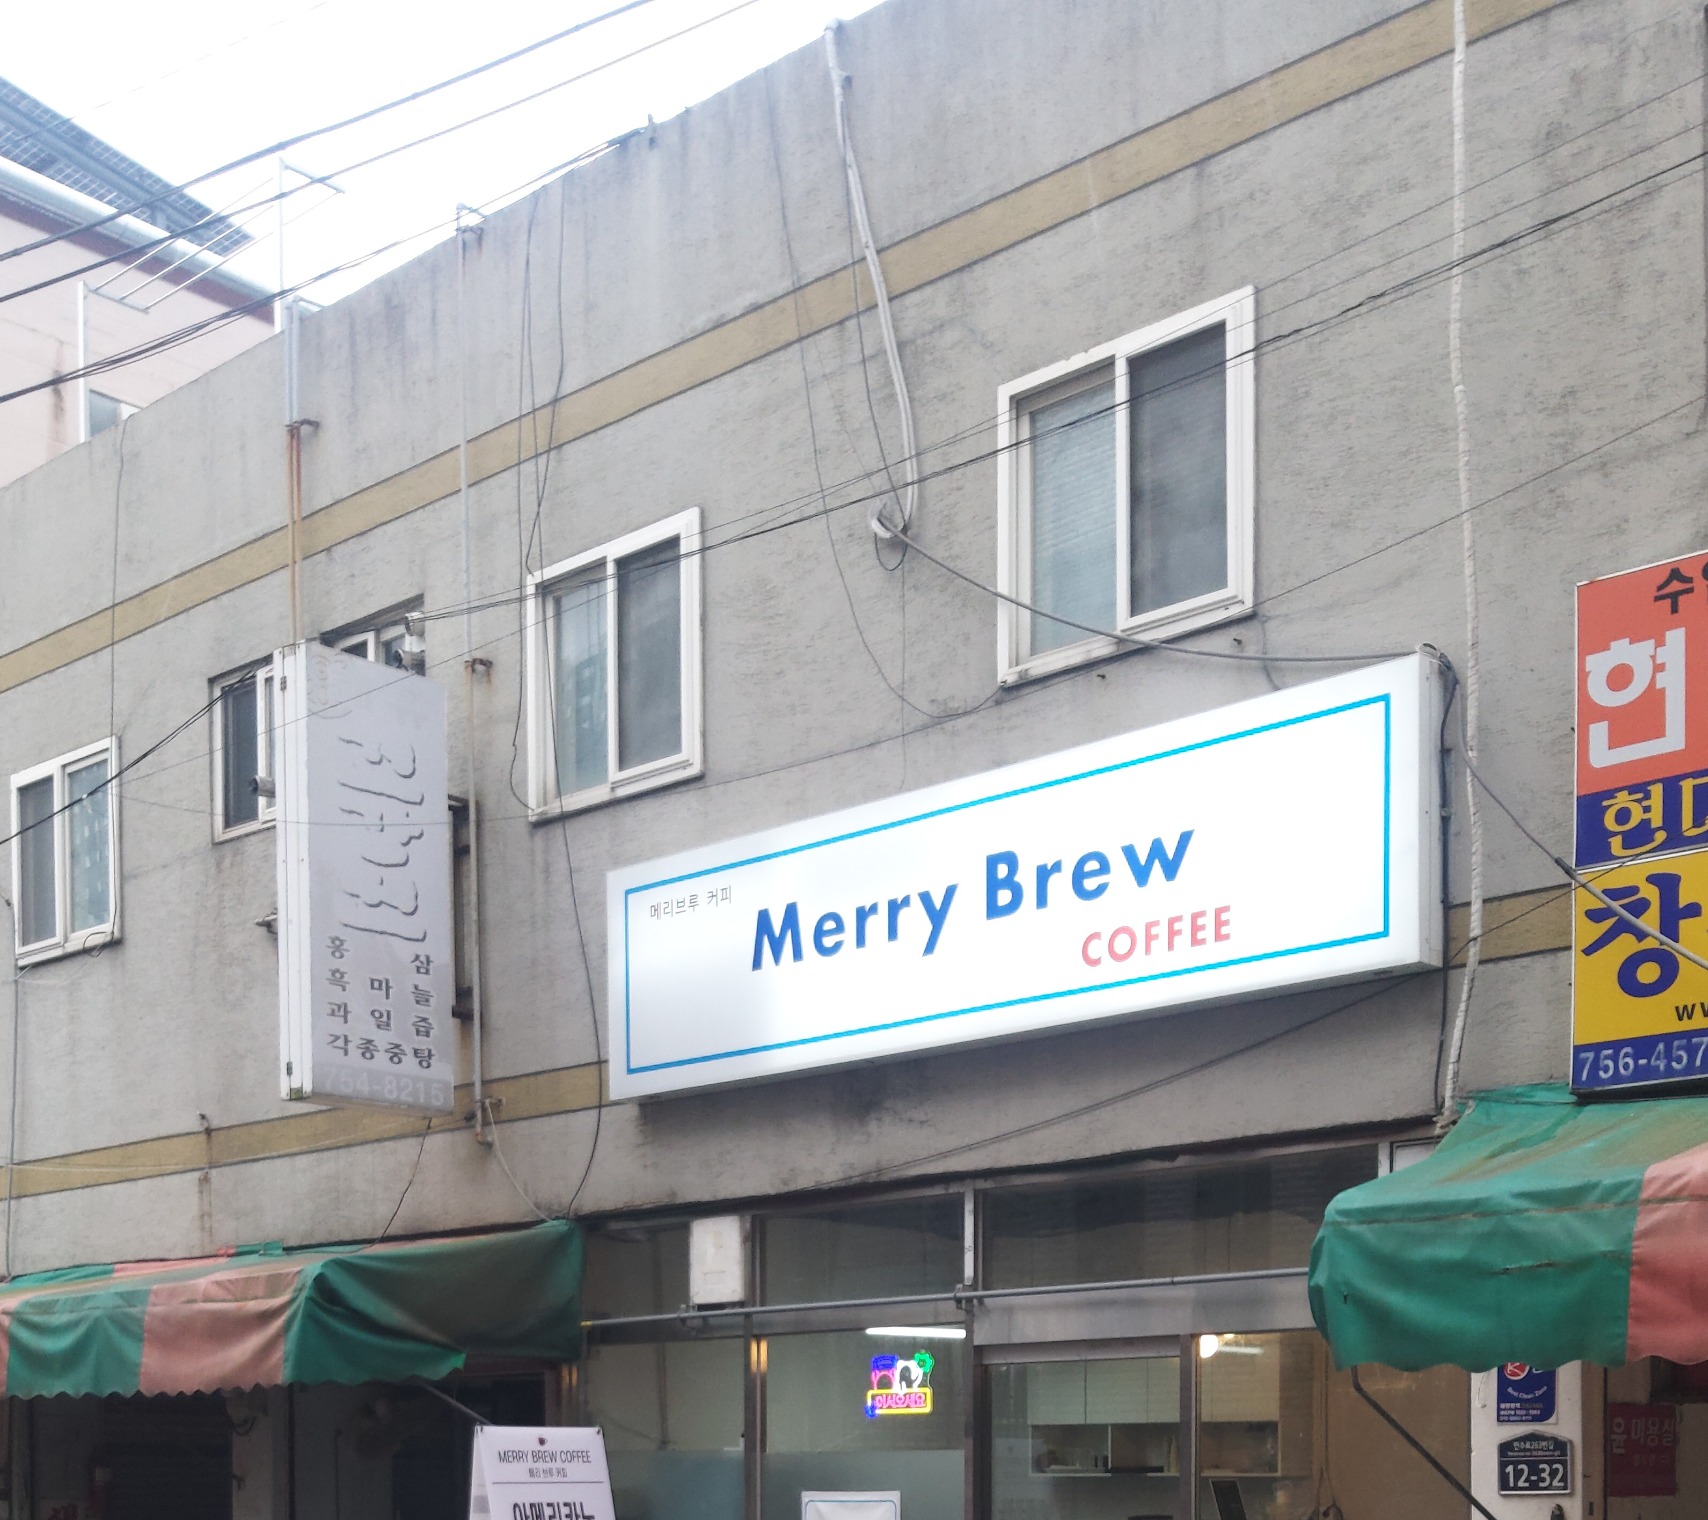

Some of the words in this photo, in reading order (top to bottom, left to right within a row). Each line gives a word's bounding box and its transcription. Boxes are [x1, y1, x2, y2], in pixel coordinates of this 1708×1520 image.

[1585, 627, 1686, 769] 현
[650, 894, 700, 921] 메리브루
[707, 885, 732, 907] 커피
[752, 882, 960, 972] Merry
[985, 829, 1195, 922] Brew
[1081, 905, 1232, 968] COFFEE
[1579, 1036, 1708, 1082] 756-457
[1632, 1416, 1675, 1447] 미용실
[498, 1450, 529, 1463] MERRY
[531, 1450, 558, 1463] BREW
[560, 1450, 592, 1463] COFFEE
[1505, 1463, 1565, 1488] 12-32
